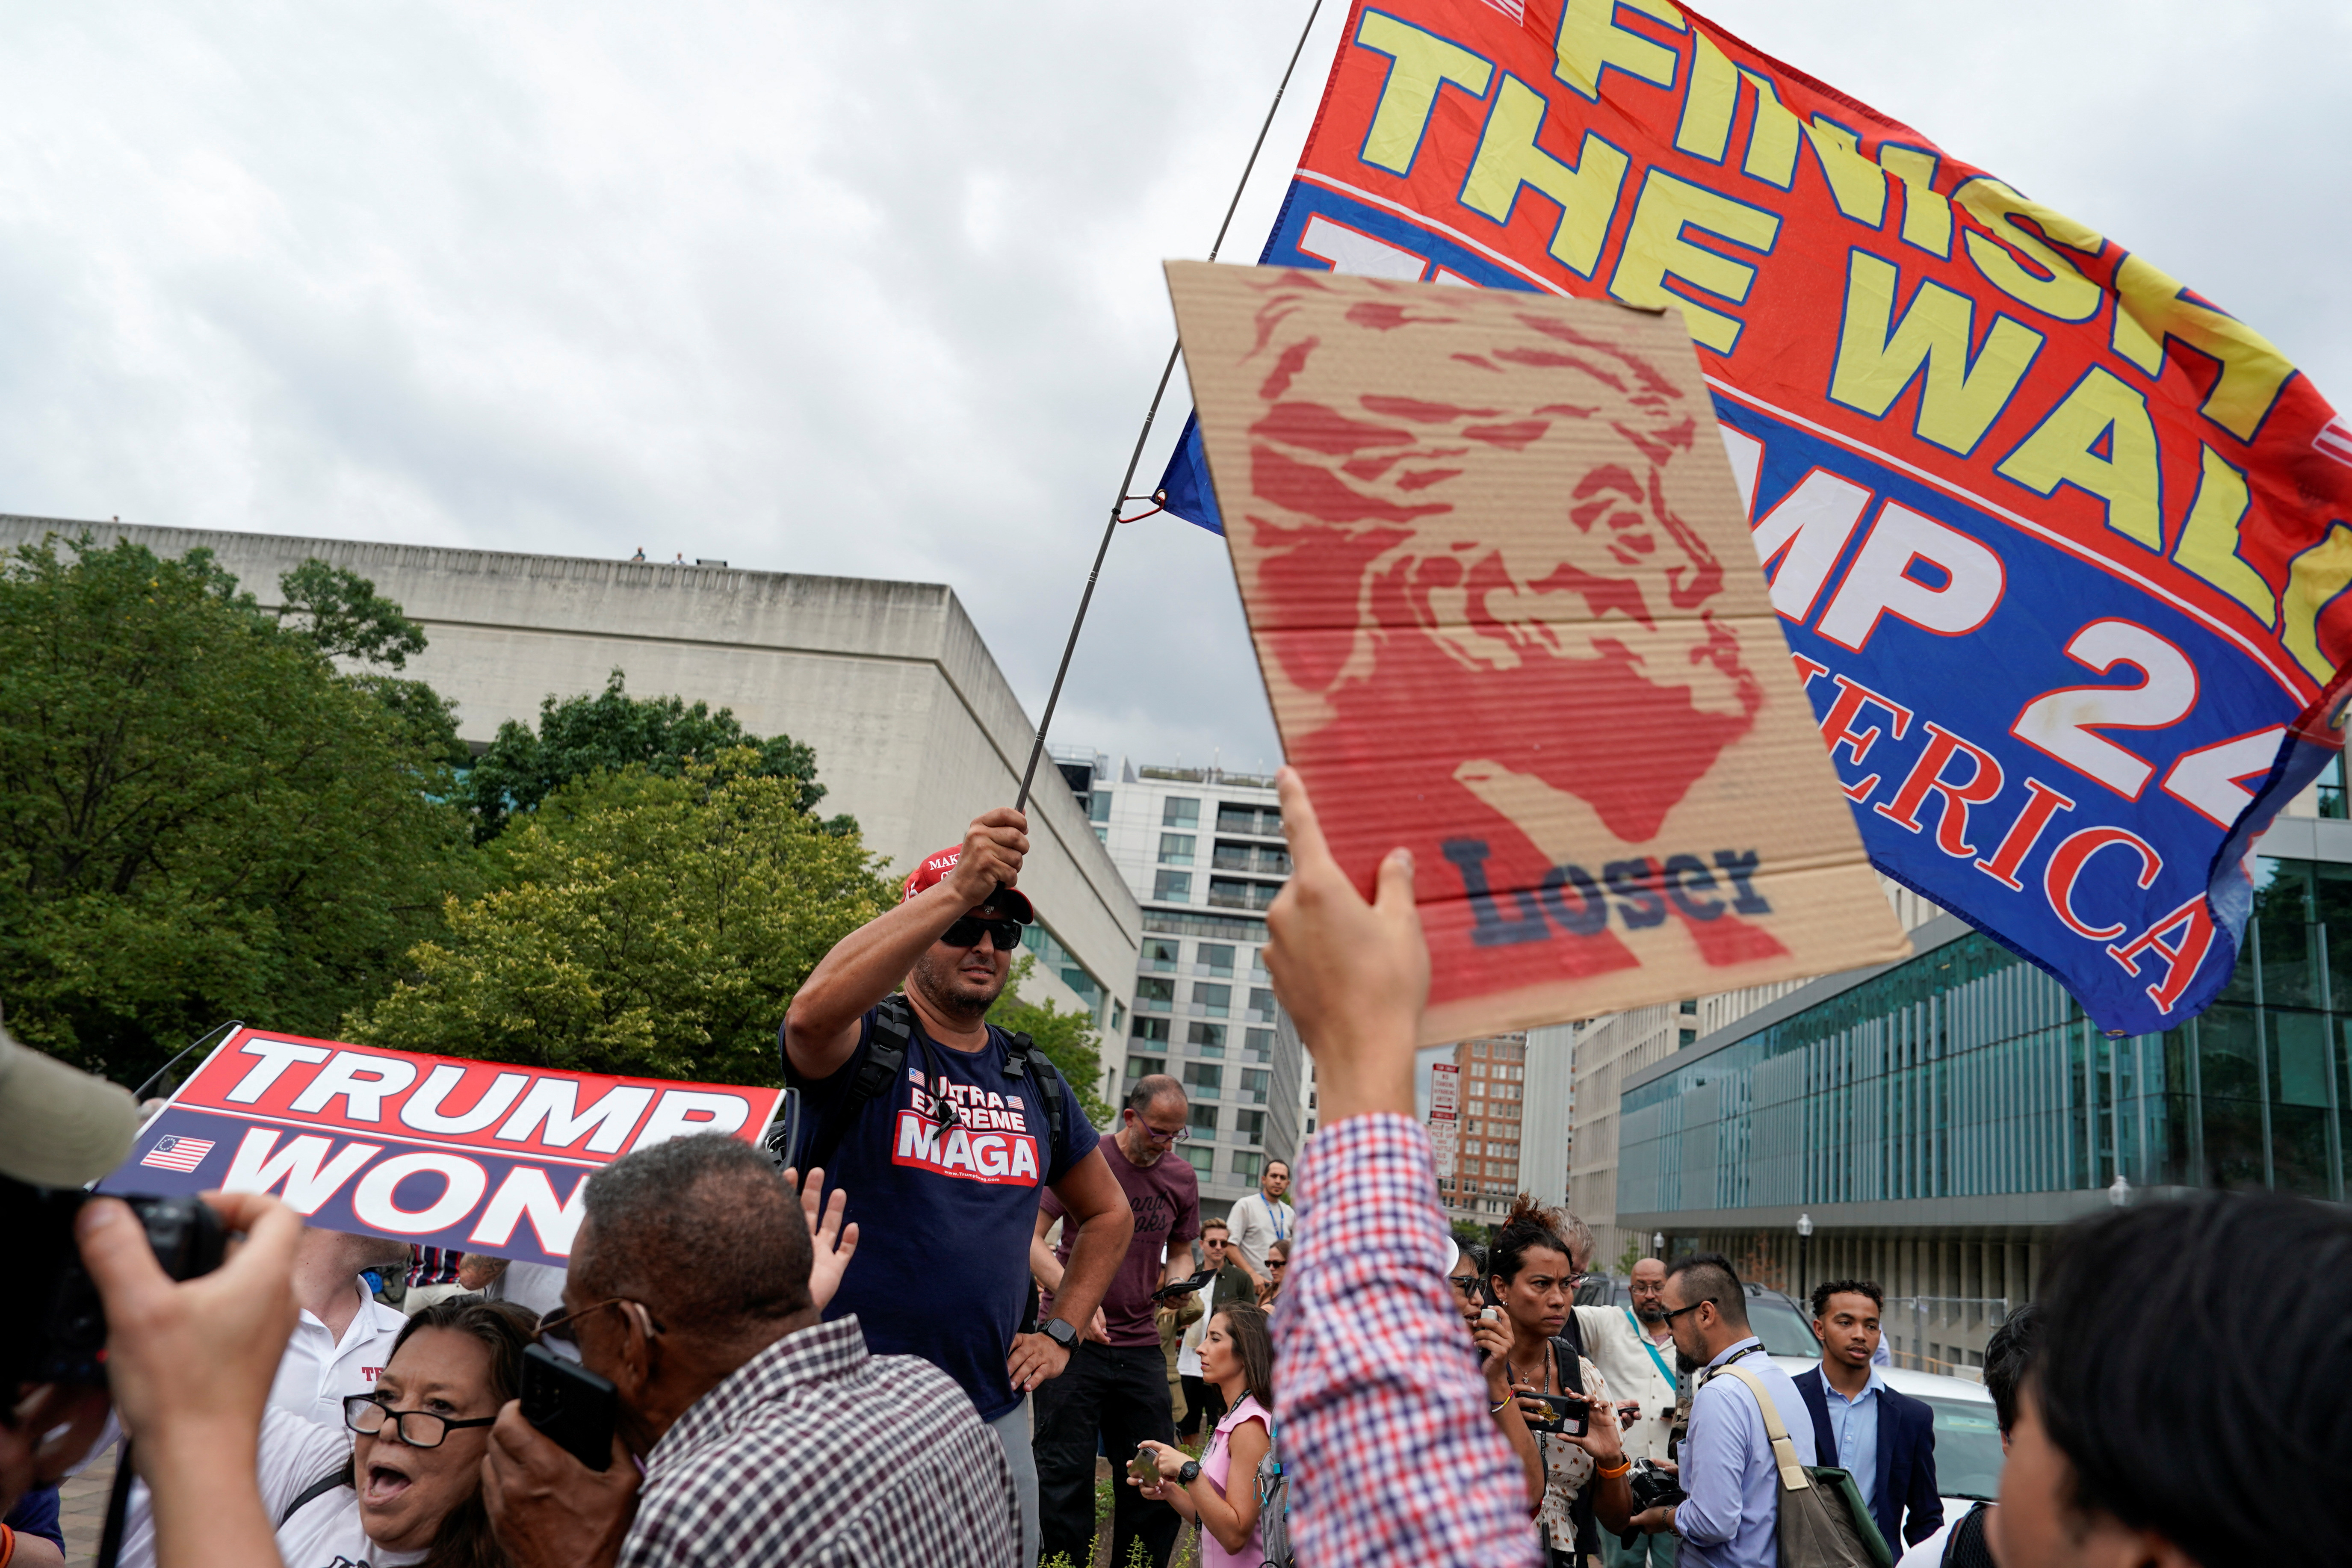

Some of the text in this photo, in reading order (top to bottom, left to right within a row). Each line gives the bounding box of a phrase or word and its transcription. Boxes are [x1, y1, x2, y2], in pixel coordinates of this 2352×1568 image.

[1552, 0, 2299, 447] FINISH
[1354, 6, 2352, 690] THE WALL
[928, 853, 961, 871] MAK
[1790, 651, 2217, 1015] ERICA
[1441, 836, 1774, 947] Loser
[225, 1037, 750, 1155] TRUMP
[897, 1115, 1038, 1180] MAGA
[911, 1087, 1026, 1132] EXTREME
[222, 1126, 591, 1256] WON
[1130, 1191, 1167, 1212] and
[1134, 1207, 1168, 1233] oks
